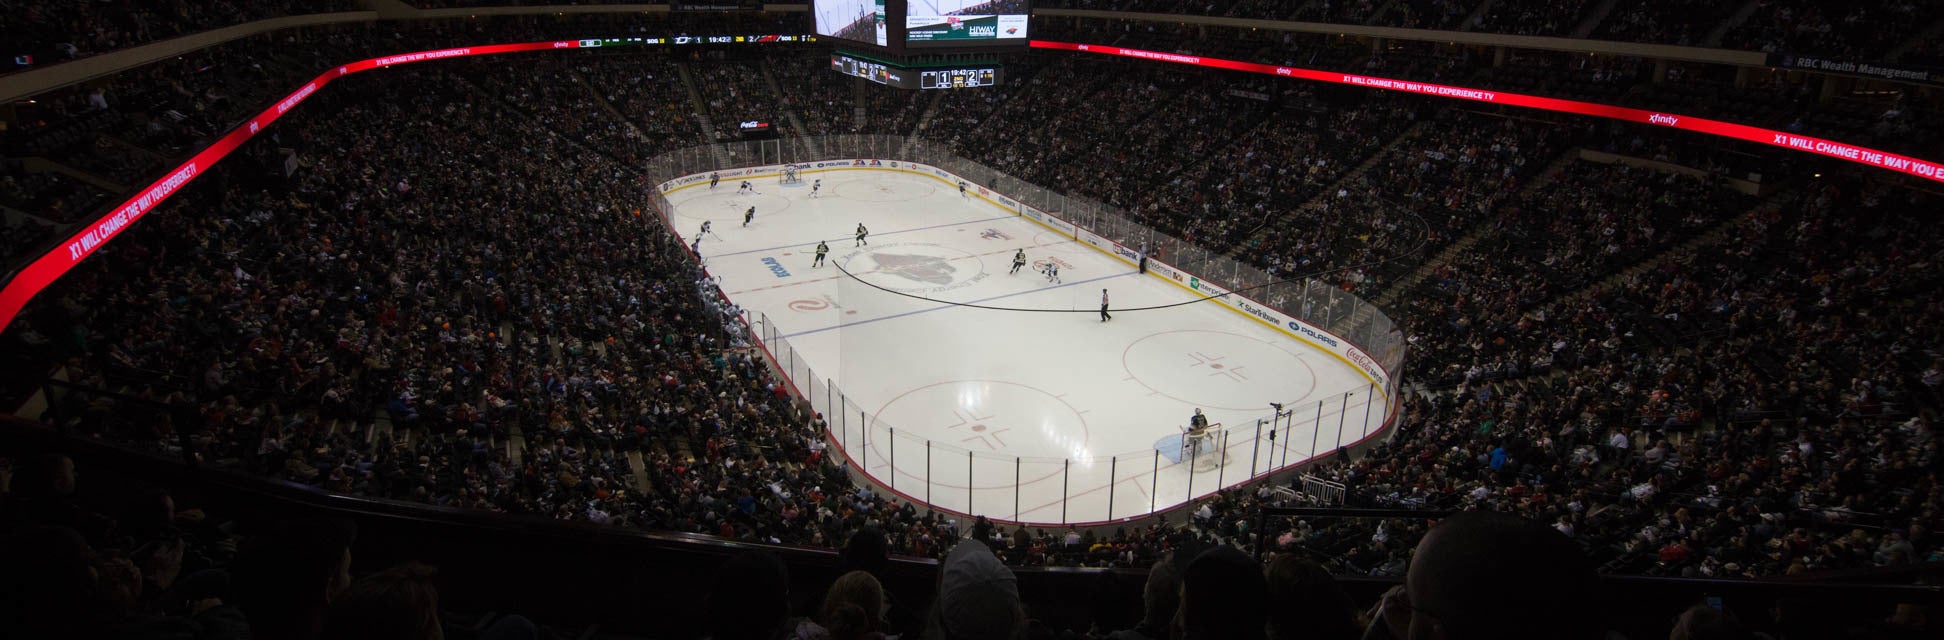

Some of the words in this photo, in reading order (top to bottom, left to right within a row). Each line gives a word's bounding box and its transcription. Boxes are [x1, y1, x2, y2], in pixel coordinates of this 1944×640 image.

[941, 73, 947, 82] 1
[968, 71, 975, 80] 2
[1797, 57, 1820, 69] RBC
[1820, 60, 1856, 73] Wealth
[1857, 63, 1929, 82] Management
[1343, 75, 1351, 83] X1
[1352, 76, 1365, 85] WILL
[1366, 78, 1392, 88] CHANGE
[1393, 81, 1405, 90] THE
[1406, 82, 1422, 91] WAY
[1422, 84, 1437, 94] YOU
[1438, 86, 1482, 100] EXPERIENCE
[1484, 92, 1494, 101] TV
[1649, 113, 1678, 126] xfinity
[1774, 133, 1787, 144] X1
[1789, 137, 1814, 150] WILL
[1816, 142, 1858, 159] CHANGE
[1861, 150, 1882, 164] THE
[1883, 155, 1911, 170] WAY
[1912, 161, 1935, 177] YOU
[69, 242, 82, 261] X1
[80, 229, 101, 252] WILL
[99, 211, 128, 239] CHANGE
[125, 205, 140, 221] THE
[137, 195, 153, 215] WAY
[150, 185, 164, 202] YOU
[161, 168, 191, 194] EXPERIENCE
[189, 162, 197, 176] TV
[1301, 326, 1337, 347] POLARIS
